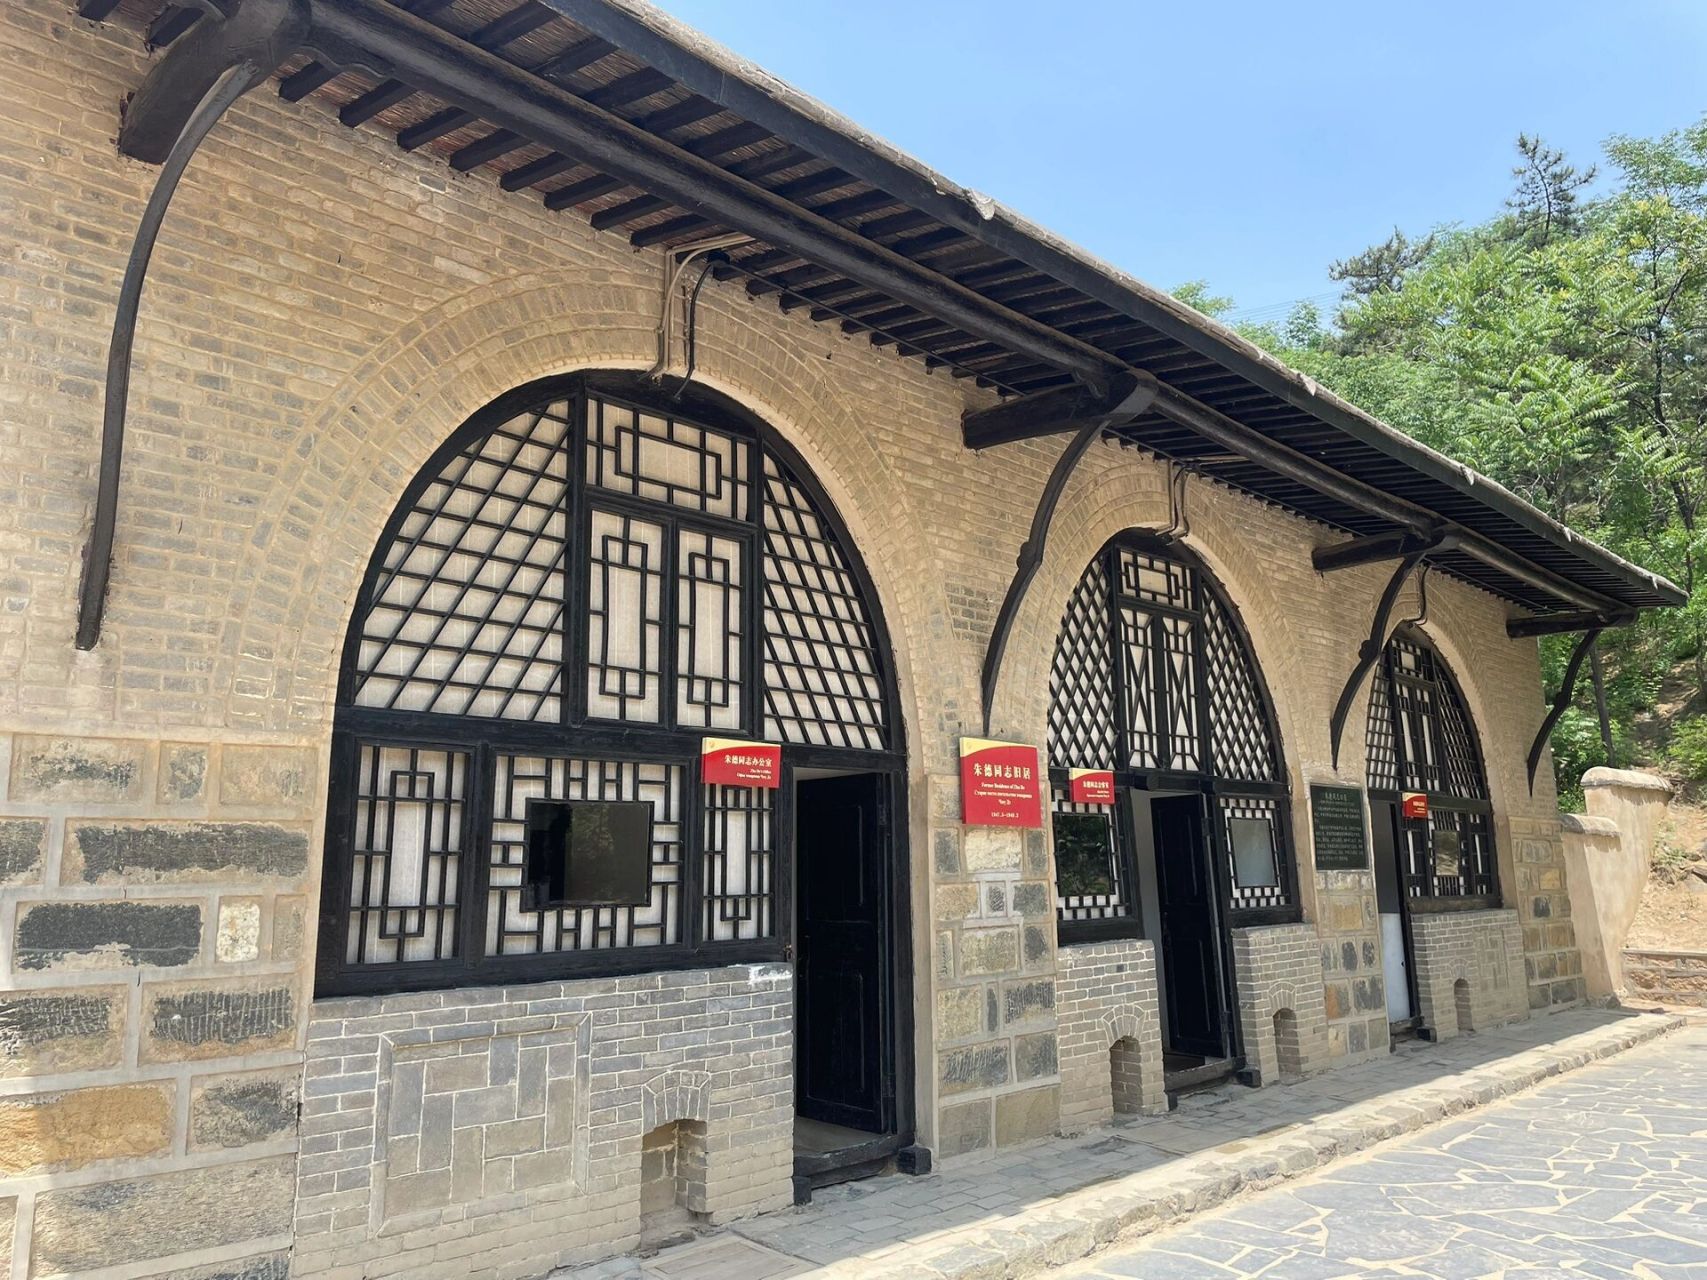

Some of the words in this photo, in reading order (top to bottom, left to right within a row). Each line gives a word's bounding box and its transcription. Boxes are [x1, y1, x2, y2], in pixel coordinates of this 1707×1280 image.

[724, 754, 772, 767] 朱德同志办公室
[974, 762, 1030, 779] 朱德同志旧居
